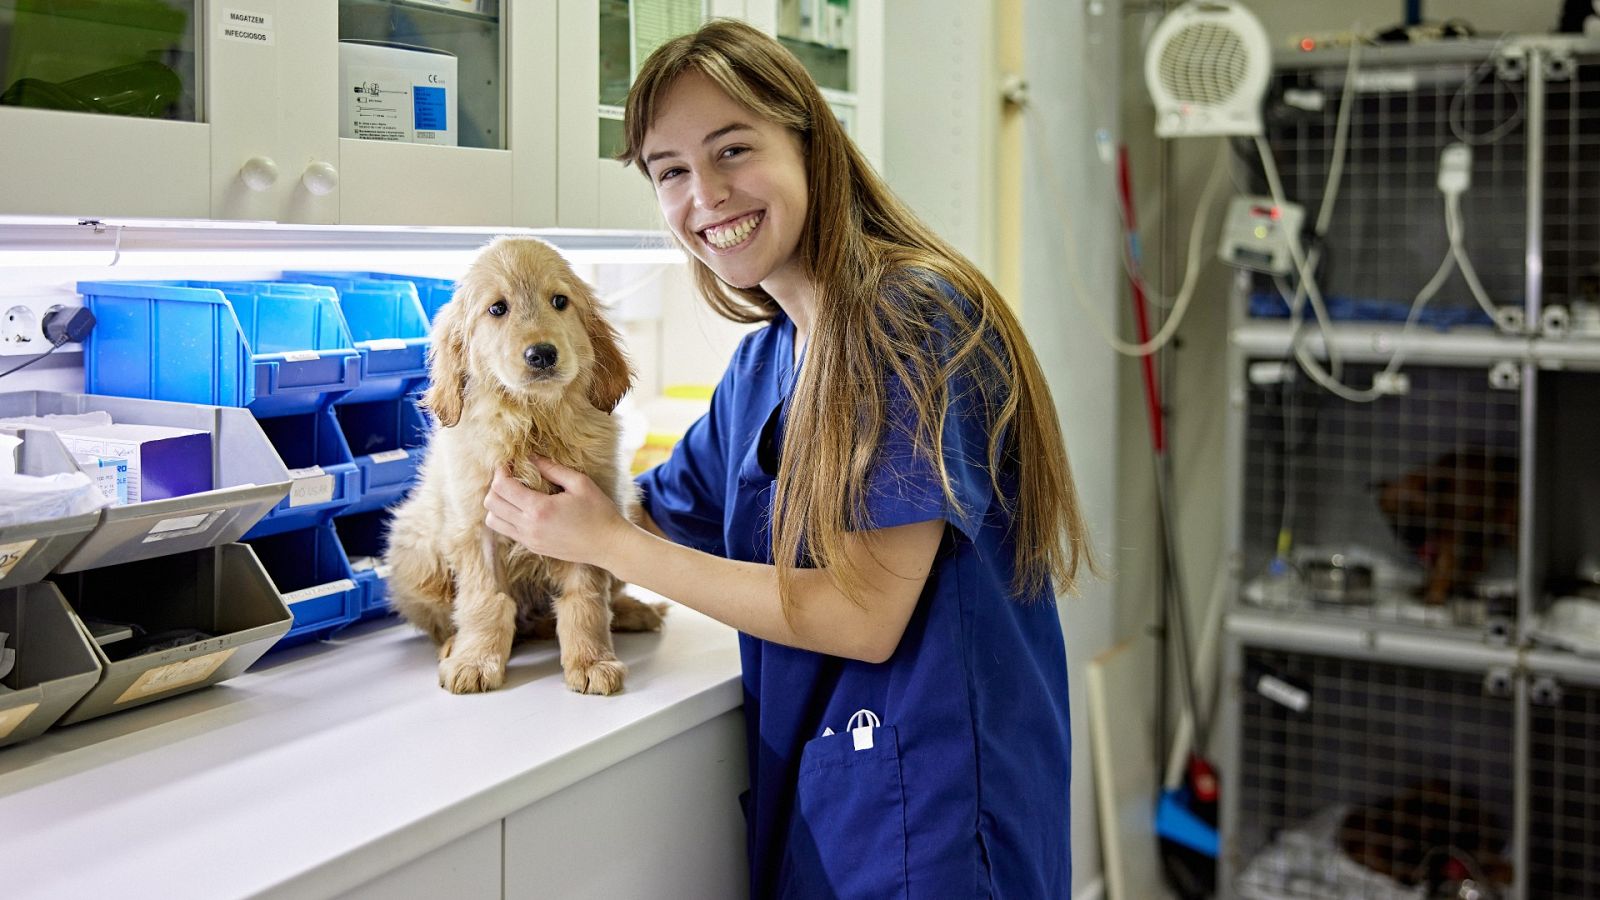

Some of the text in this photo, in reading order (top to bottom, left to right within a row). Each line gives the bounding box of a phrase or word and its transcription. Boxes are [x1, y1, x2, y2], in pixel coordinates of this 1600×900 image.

[230, 13, 265, 24] MAGATZEM
[224, 29, 267, 41] INFECCIOSOS
[428, 74, 438, 83] CE
